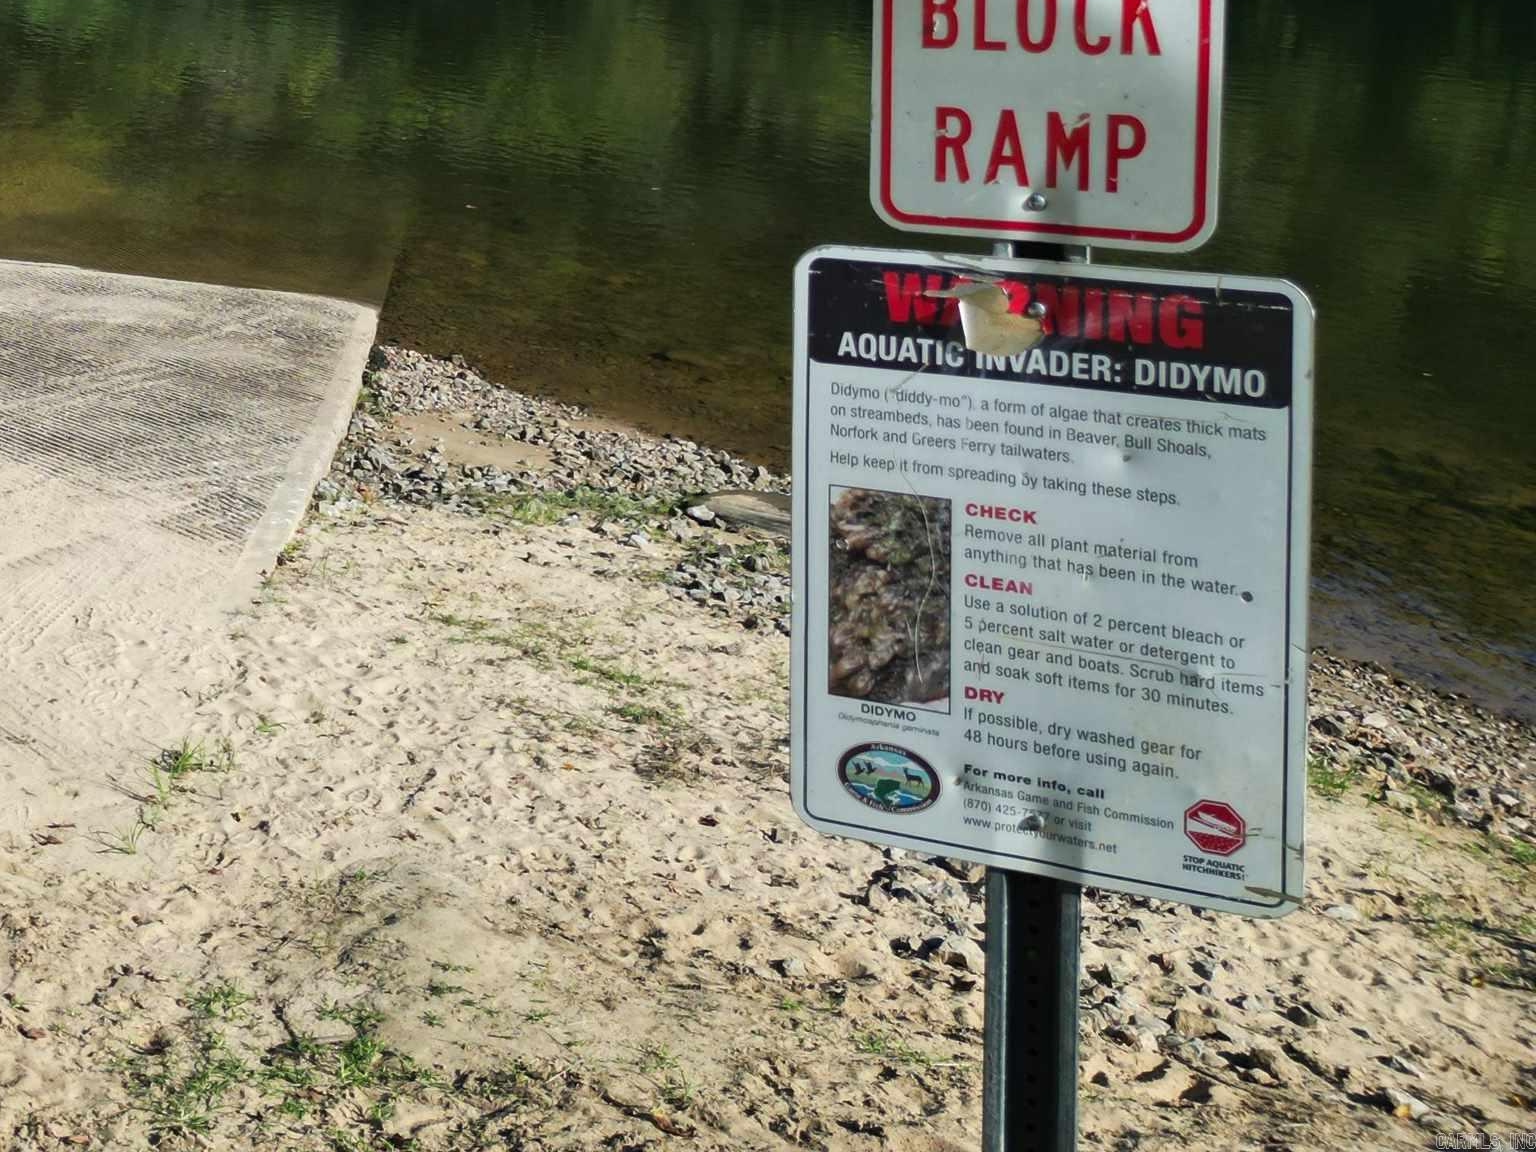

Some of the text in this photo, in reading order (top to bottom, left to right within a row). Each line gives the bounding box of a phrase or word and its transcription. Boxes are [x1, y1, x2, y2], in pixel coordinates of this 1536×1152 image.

[933, 106, 1147, 193] RAMP
[837, 331, 1266, 398] AQUATIC INVADER: DIDYMO
[830, 382, 880, 400] Didymo
[980, 399, 989, 411] a
[994, 398, 1026, 415] form
[1031, 401, 1044, 417] of
[1049, 404, 1088, 422] algae
[1093, 408, 1122, 425] that
[1126, 414, 1182, 433] creates
[1186, 419, 1223, 437] thick
[1228, 425, 1267, 441] mats
[830, 405, 846, 417] on
[936, 414, 961, 429] has
[966, 417, 999, 433] been
[1004, 421, 1044, 438] found
[1049, 425, 1061, 440] in
[1124, 434, 1152, 450] Bull
[1157, 438, 1212, 459] Shoals,
[830, 424, 878, 441] Norfork
[883, 430, 907, 444] and
[912, 431, 956, 449] Greers
[961, 438, 996, 456] Ferry
[830, 451, 1180, 506] Help keep it from spreading by taking these steps.
[965, 503, 1037, 525] CHECK
[965, 524, 1198, 568] Remove all plant material from
[965, 548, 1027, 569] anything
[1033, 555, 1061, 571] that
[1067, 559, 1094, 576] has
[1099, 564, 1136, 582] been
[1142, 569, 1155, 584] in
[1161, 572, 1185, 589] the
[965, 574, 1033, 596] CLEAN
[964, 594, 1245, 648] Use a solution of 2 percent bleach or
[964, 616, 1235, 670] 5 percent salt water or detergent to
[964, 638, 1264, 697] clean gear and boats. Scrub hard items
[964, 660, 1234, 714] and soak soft items for 30 minutes.
[861, 703, 917, 722] DIDYMO
[964, 686, 1004, 704] DRY
[964, 707, 1202, 761] If possible, dry washed gear for
[964, 728, 1180, 780] 48 hours before using again.
[963, 781, 1175, 830] Arkansas Game and Fish Commission
[964, 764, 988, 777] For
[993, 770, 1032, 785] more
[1076, 786, 1105, 799] call
[963, 798, 992, 814] (870)
[1054, 815, 1066, 825] or
[1068, 817, 1092, 833] visit
[1183, 854, 1245, 873] STOP AQUATIC
